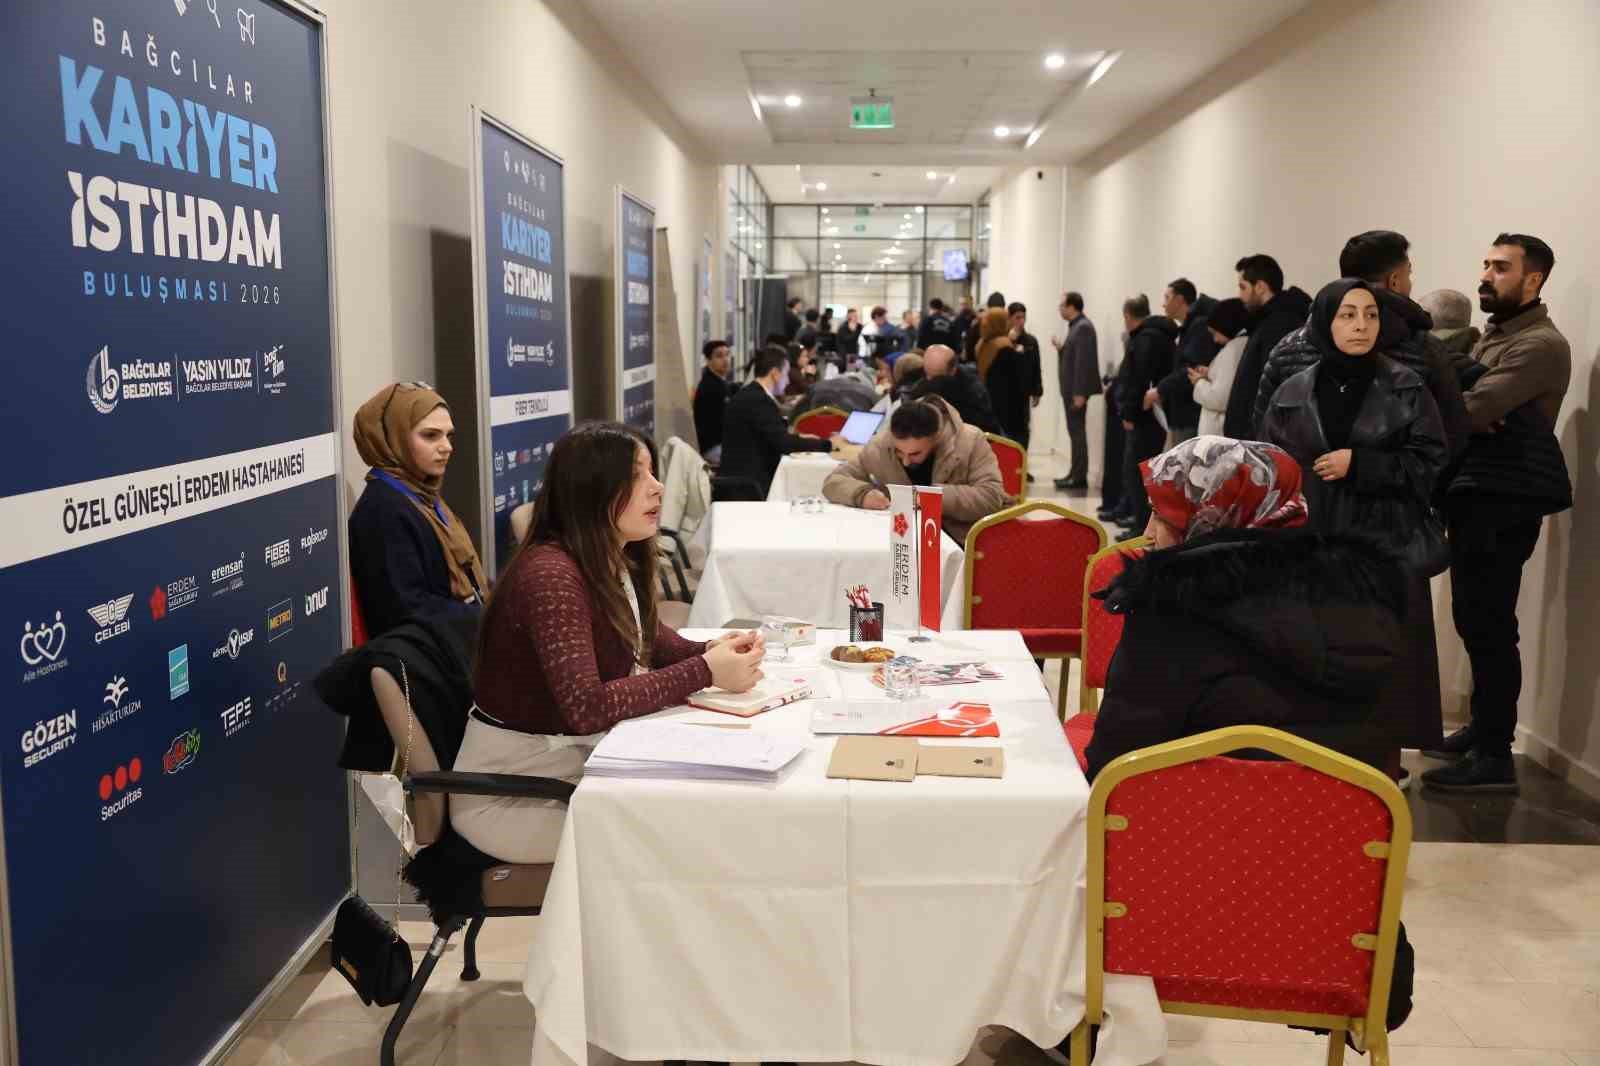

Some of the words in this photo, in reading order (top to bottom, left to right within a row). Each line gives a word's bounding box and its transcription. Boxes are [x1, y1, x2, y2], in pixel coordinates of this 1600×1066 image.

[92, 17, 253, 104] BAĞCILAR
[58, 54, 279, 194] KARİYER
[67, 170, 283, 270] İSTİHDAM
[501, 211, 552, 264] KARİYER
[84, 271, 228, 303] BULUŞMASI
[240, 284, 281, 305] 2026
[503, 260, 553, 303] İSTİHDAM
[121, 359, 171, 380] BAĞCILAR
[182, 360, 217, 382] YASİN
[218, 358, 252, 380] YILDIZ
[122, 381, 173, 400] BELEDİYESİ
[63, 497, 111, 534] ÖZEL
[114, 475, 182, 522] GÜNEŞLİ
[184, 471, 230, 504] ERDEM
[232, 448, 305, 492] HASTAHANESİ
[167, 575, 196, 597] ERDEM
[211, 559, 244, 581] erensan
[901, 543, 909, 596] ERDEM
[269, 608, 291, 631] METRO
[220, 696, 252, 730] TEPE
[21, 708, 77, 753] GÖZEN
[24, 733, 77, 768] SECURITY
[101, 787, 142, 821] Securitas
